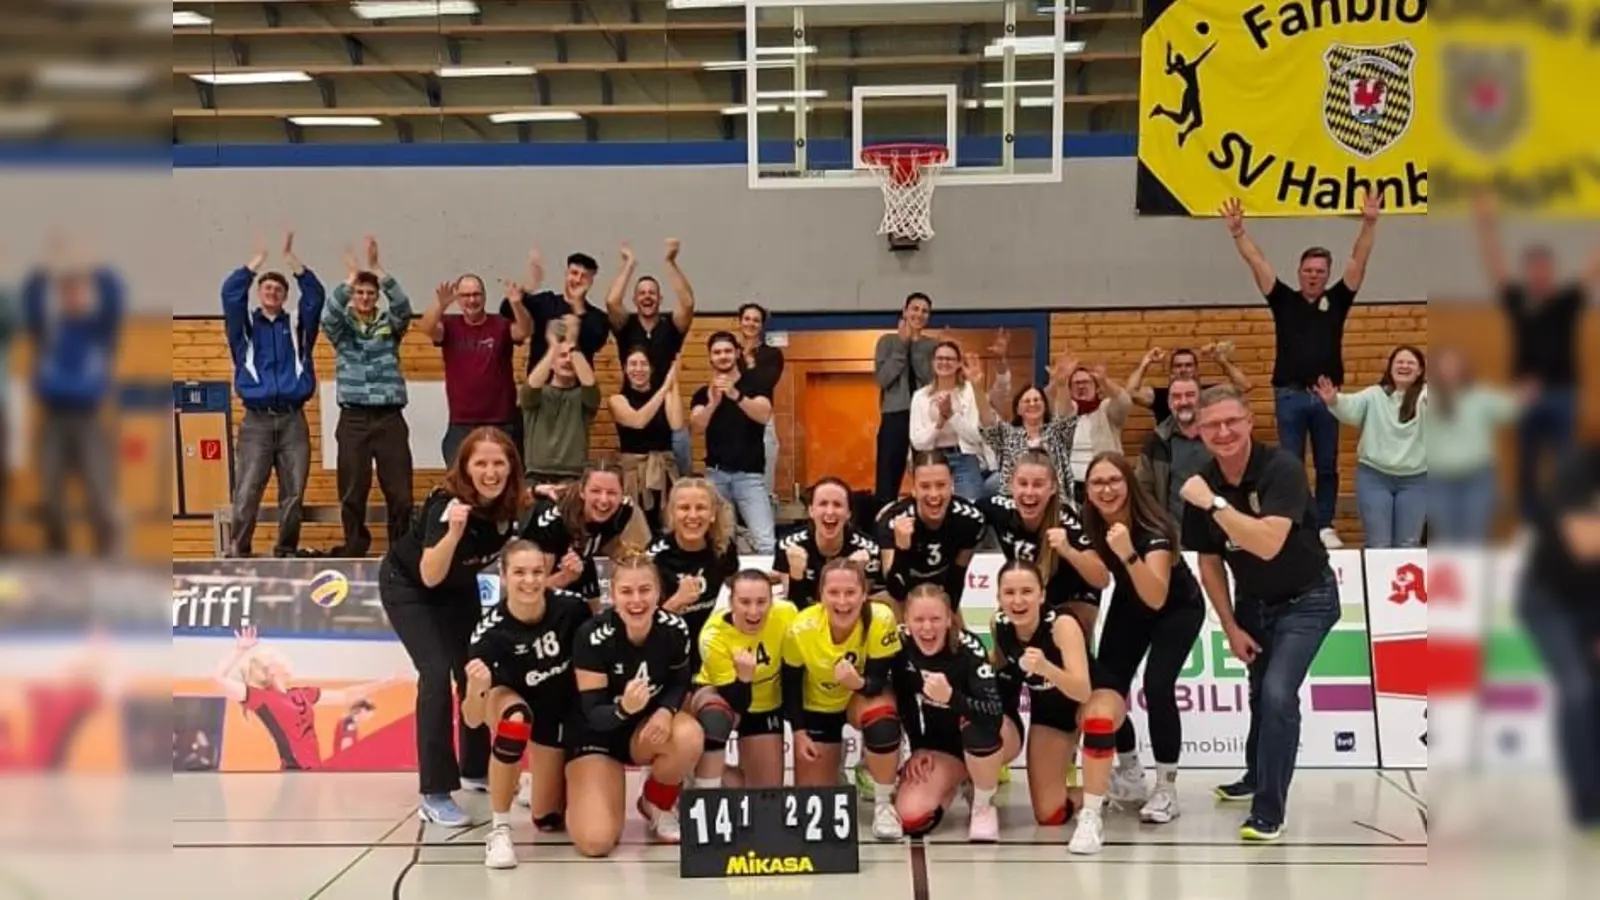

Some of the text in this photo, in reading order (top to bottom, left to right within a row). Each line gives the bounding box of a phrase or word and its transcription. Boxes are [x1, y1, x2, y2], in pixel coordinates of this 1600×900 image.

[1207, 132, 1277, 188] SV
[926, 543, 942, 565] 3
[173, 585, 252, 627] riff!
[532, 630, 560, 660] 18
[635, 660, 651, 687] 4
[689, 797, 732, 844] 14
[740, 795, 750, 827] 1
[785, 795, 799, 827] 2
